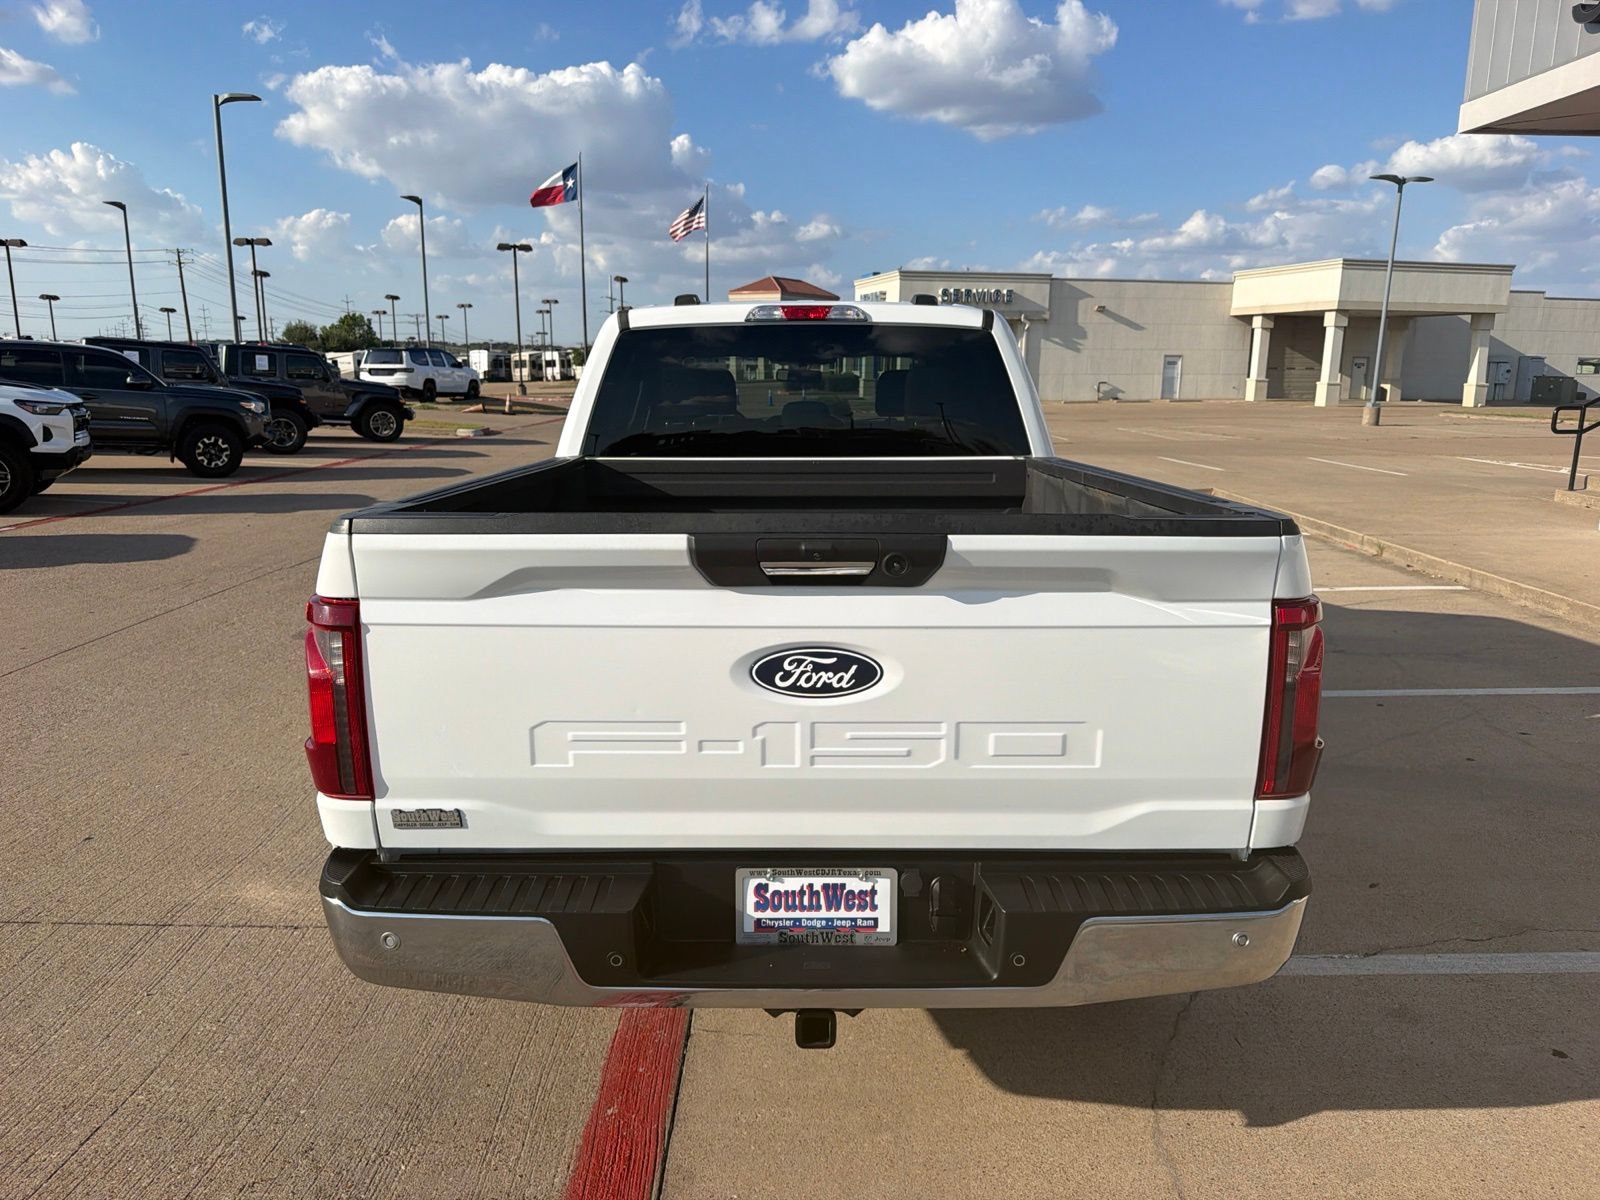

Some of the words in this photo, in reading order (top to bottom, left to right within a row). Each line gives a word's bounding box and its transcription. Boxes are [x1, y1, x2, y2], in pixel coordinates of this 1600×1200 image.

[938, 288, 1014, 304] SERVICE
[775, 655, 858, 688] Ford
[528, 720, 1103, 768] F-150
[390, 808, 462, 822] SouthWest
[754, 882, 878, 912] SouthWest
[760, 918, 794, 928] Chrysler
[801, 918, 827, 928] Dodge
[832, 918, 851, 928] Jeep
[856, 918, 875, 927] Ram
[777, 931, 856, 945] SouthWest
